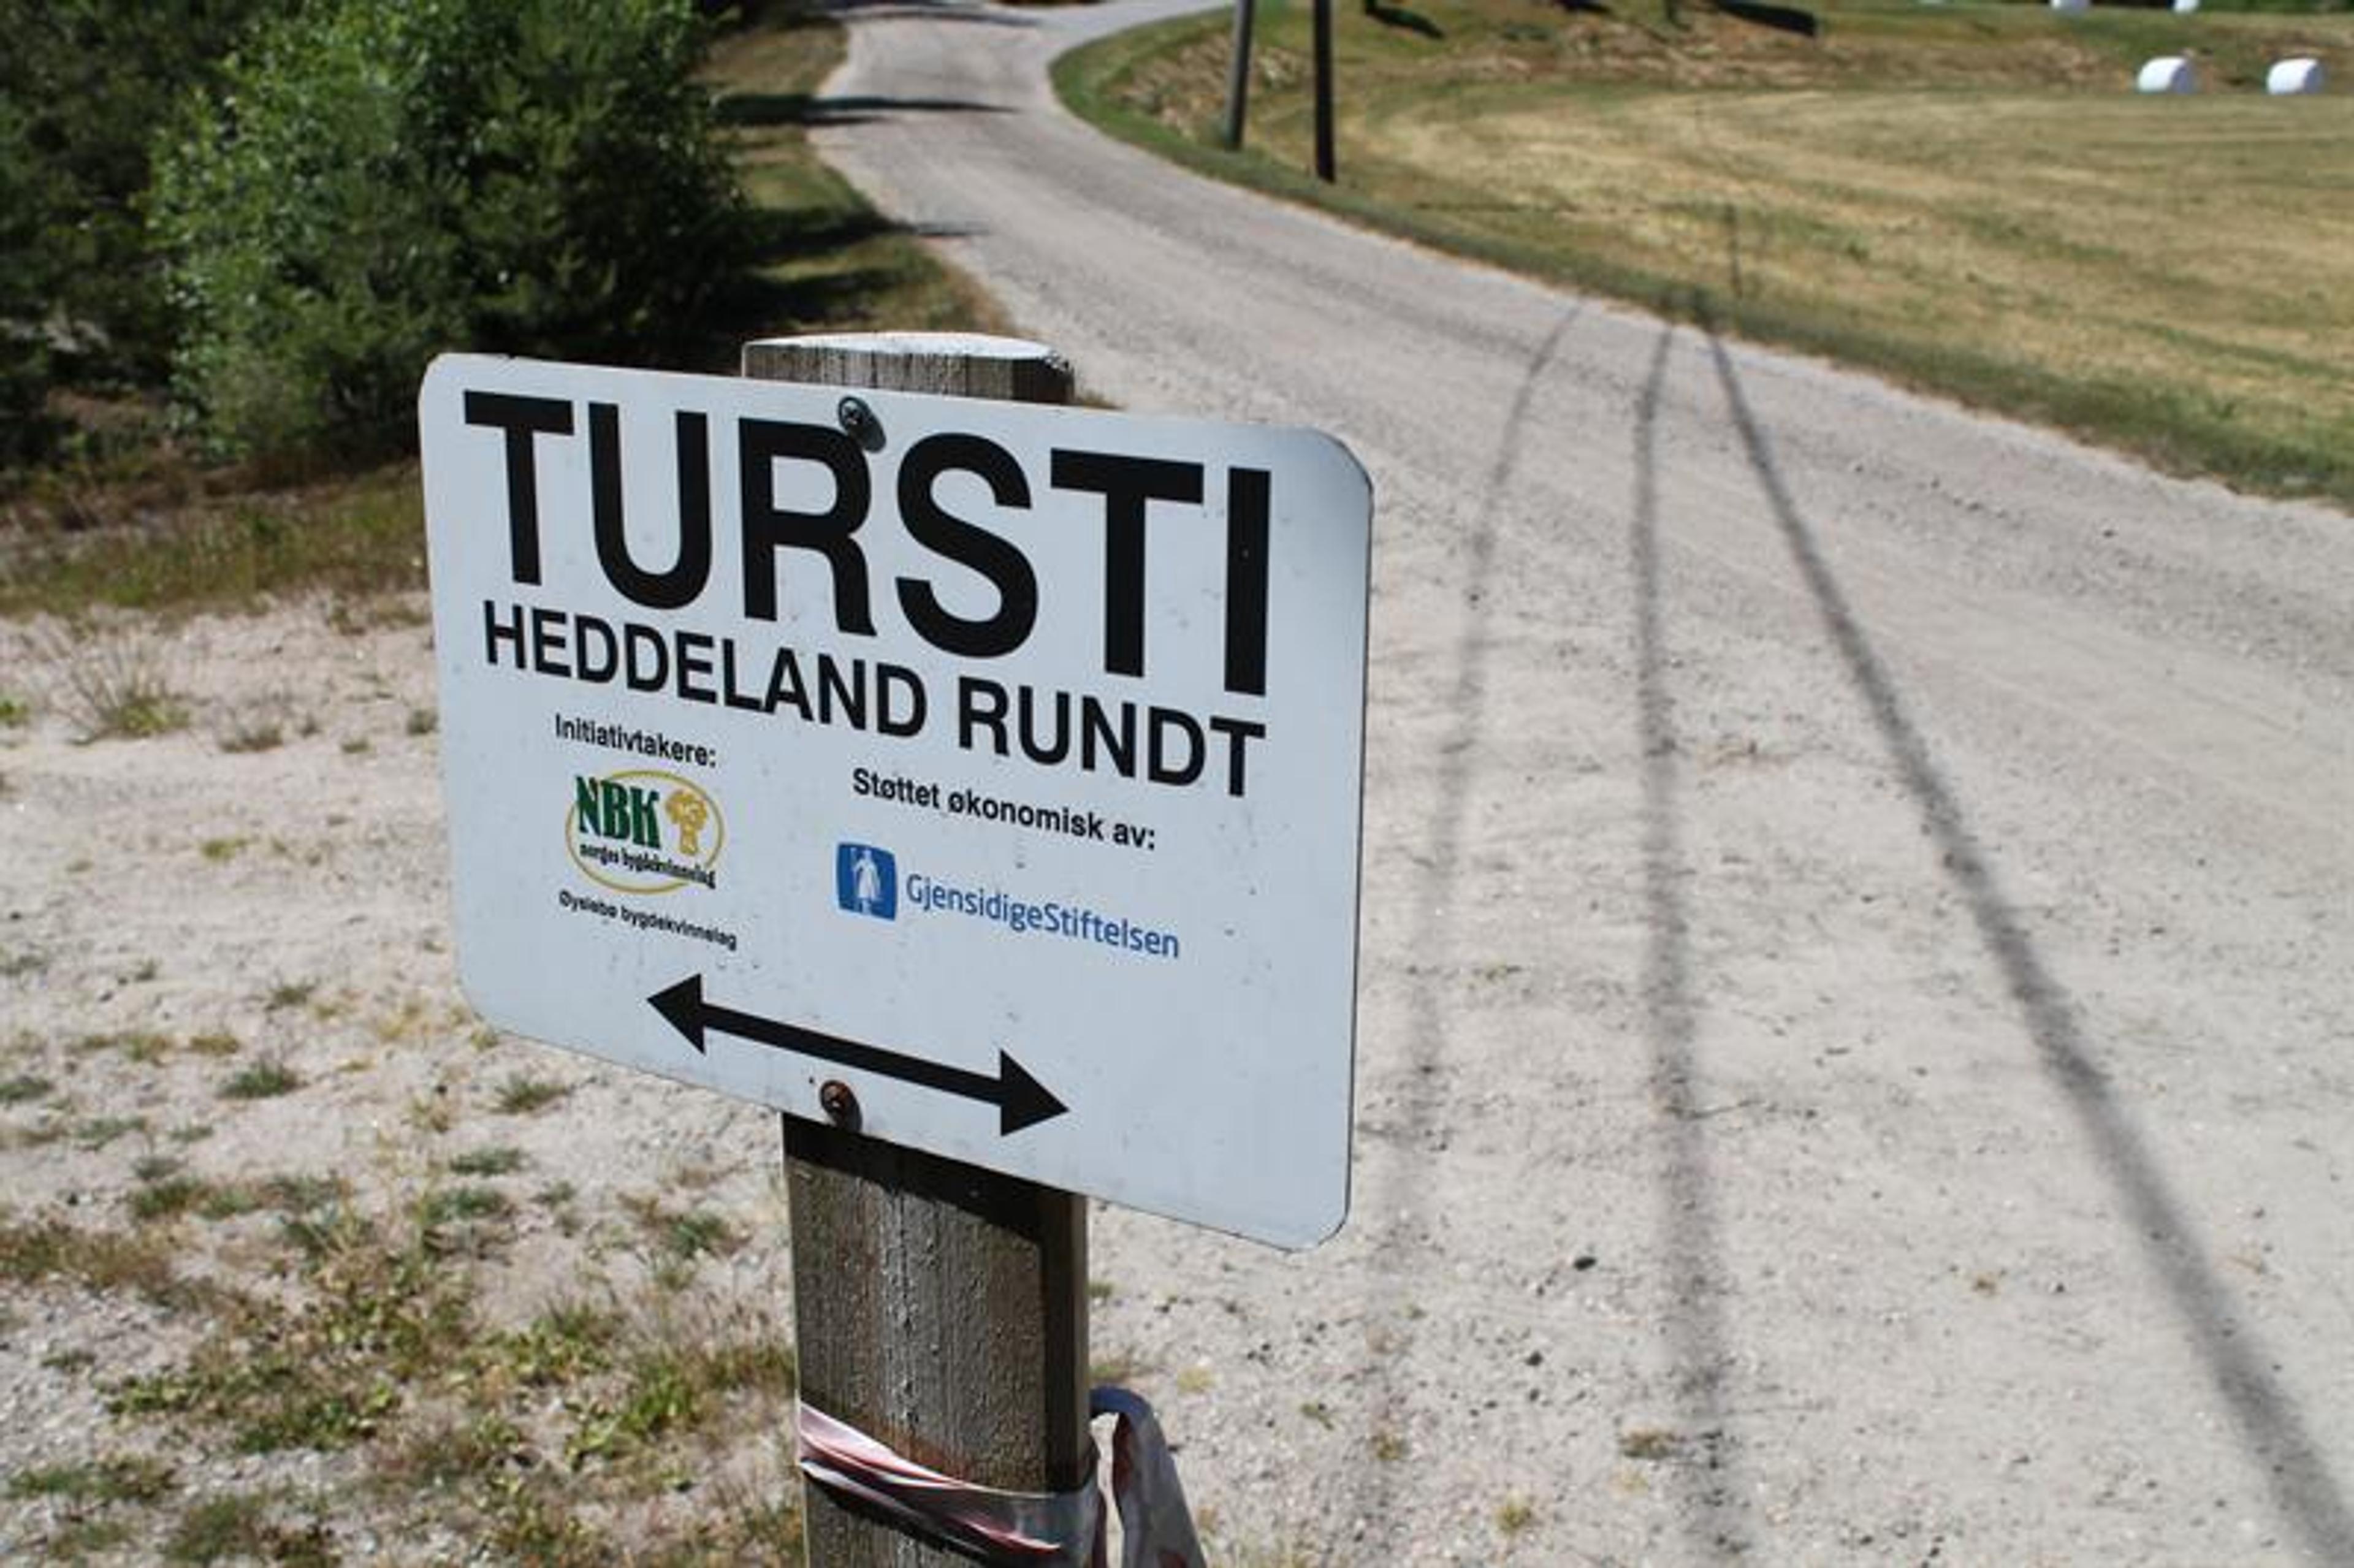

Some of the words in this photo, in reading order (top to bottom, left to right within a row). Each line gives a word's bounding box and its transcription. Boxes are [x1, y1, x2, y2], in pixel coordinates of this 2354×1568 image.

[464, 390, 1271, 696] TURSTI
[484, 600, 927, 737] HEDDELAND
[958, 676, 1265, 797] RUNDT
[555, 713, 717, 767] Initiativtakere:
[575, 775, 661, 849] NBK
[853, 767, 940, 809] Støttet
[948, 791, 1104, 841] økonomisk
[1113, 825, 1155, 850] av:
[620, 905, 737, 951] bygdekvinnelag
[906, 875, 1180, 958] GjensidigeStiftelsen
